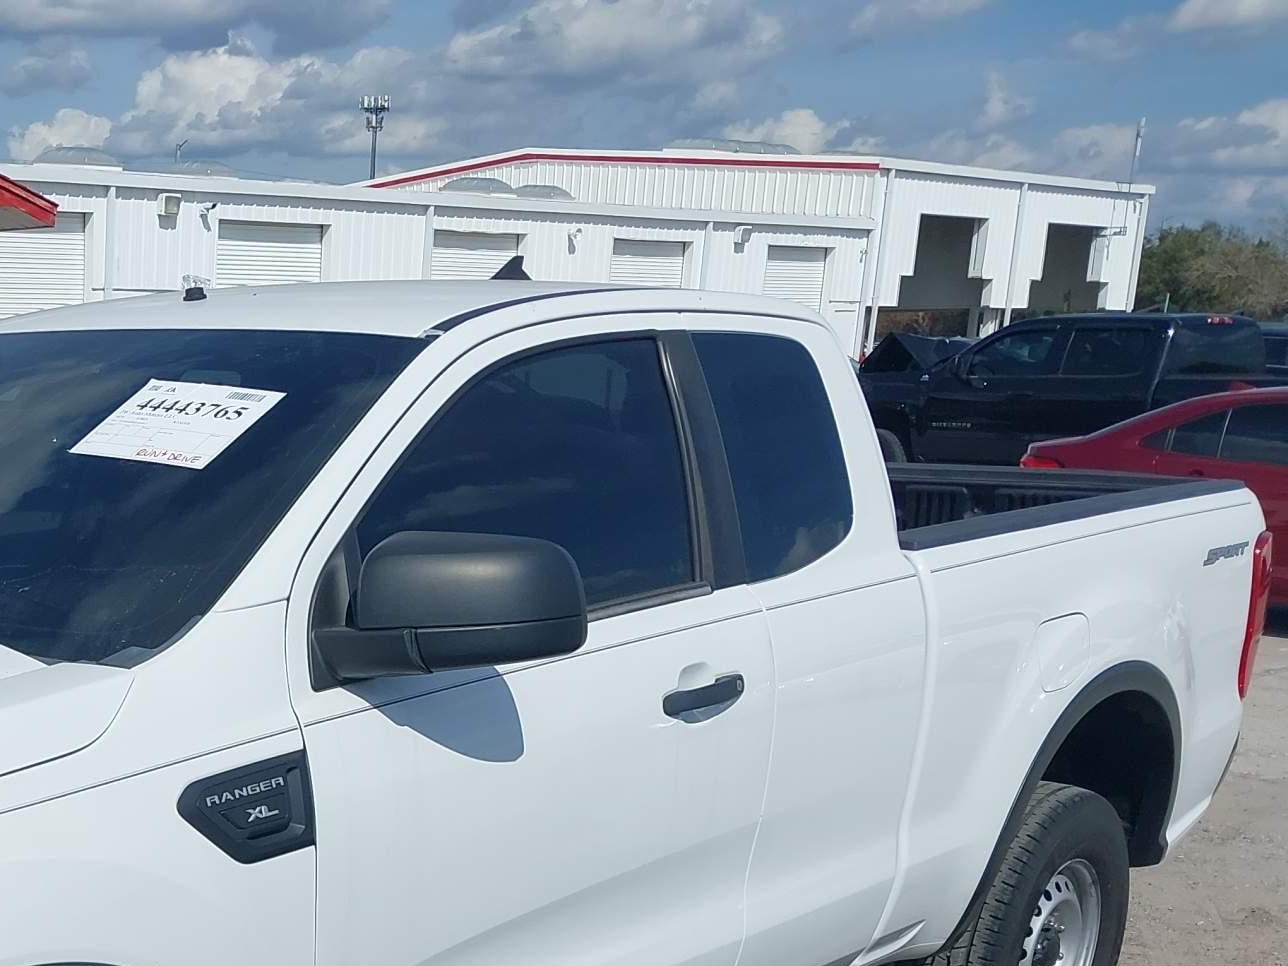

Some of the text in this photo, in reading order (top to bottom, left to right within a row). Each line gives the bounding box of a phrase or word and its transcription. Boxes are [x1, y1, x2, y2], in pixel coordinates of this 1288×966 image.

[136, 398, 251, 421] 44443765
[167, 452, 202, 464] DRIVE
[1203, 540, 1250, 567] SPORT
[205, 776, 285, 807] RANGER
[245, 805, 280, 822] XL
